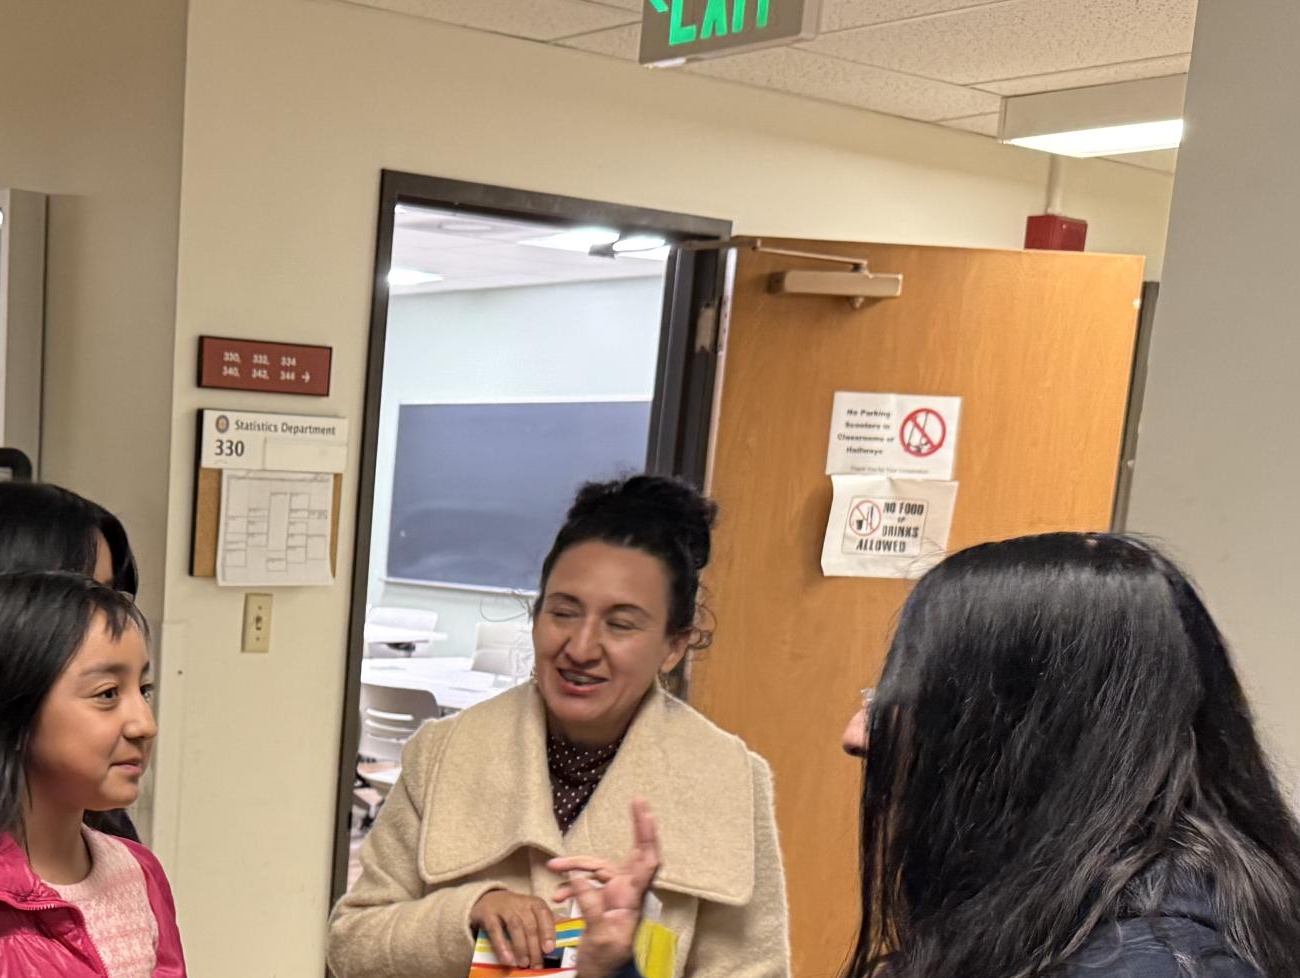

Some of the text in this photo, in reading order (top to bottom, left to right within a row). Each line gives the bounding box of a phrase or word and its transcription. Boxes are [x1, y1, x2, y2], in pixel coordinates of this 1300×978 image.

[234, 419, 337, 437] Statistics Department
[214, 439, 245, 457] 330
[884, 502, 925, 516] NO FOOD
[882, 525, 919, 539] DRINKS
[856, 538, 907, 553] ALLOWED
